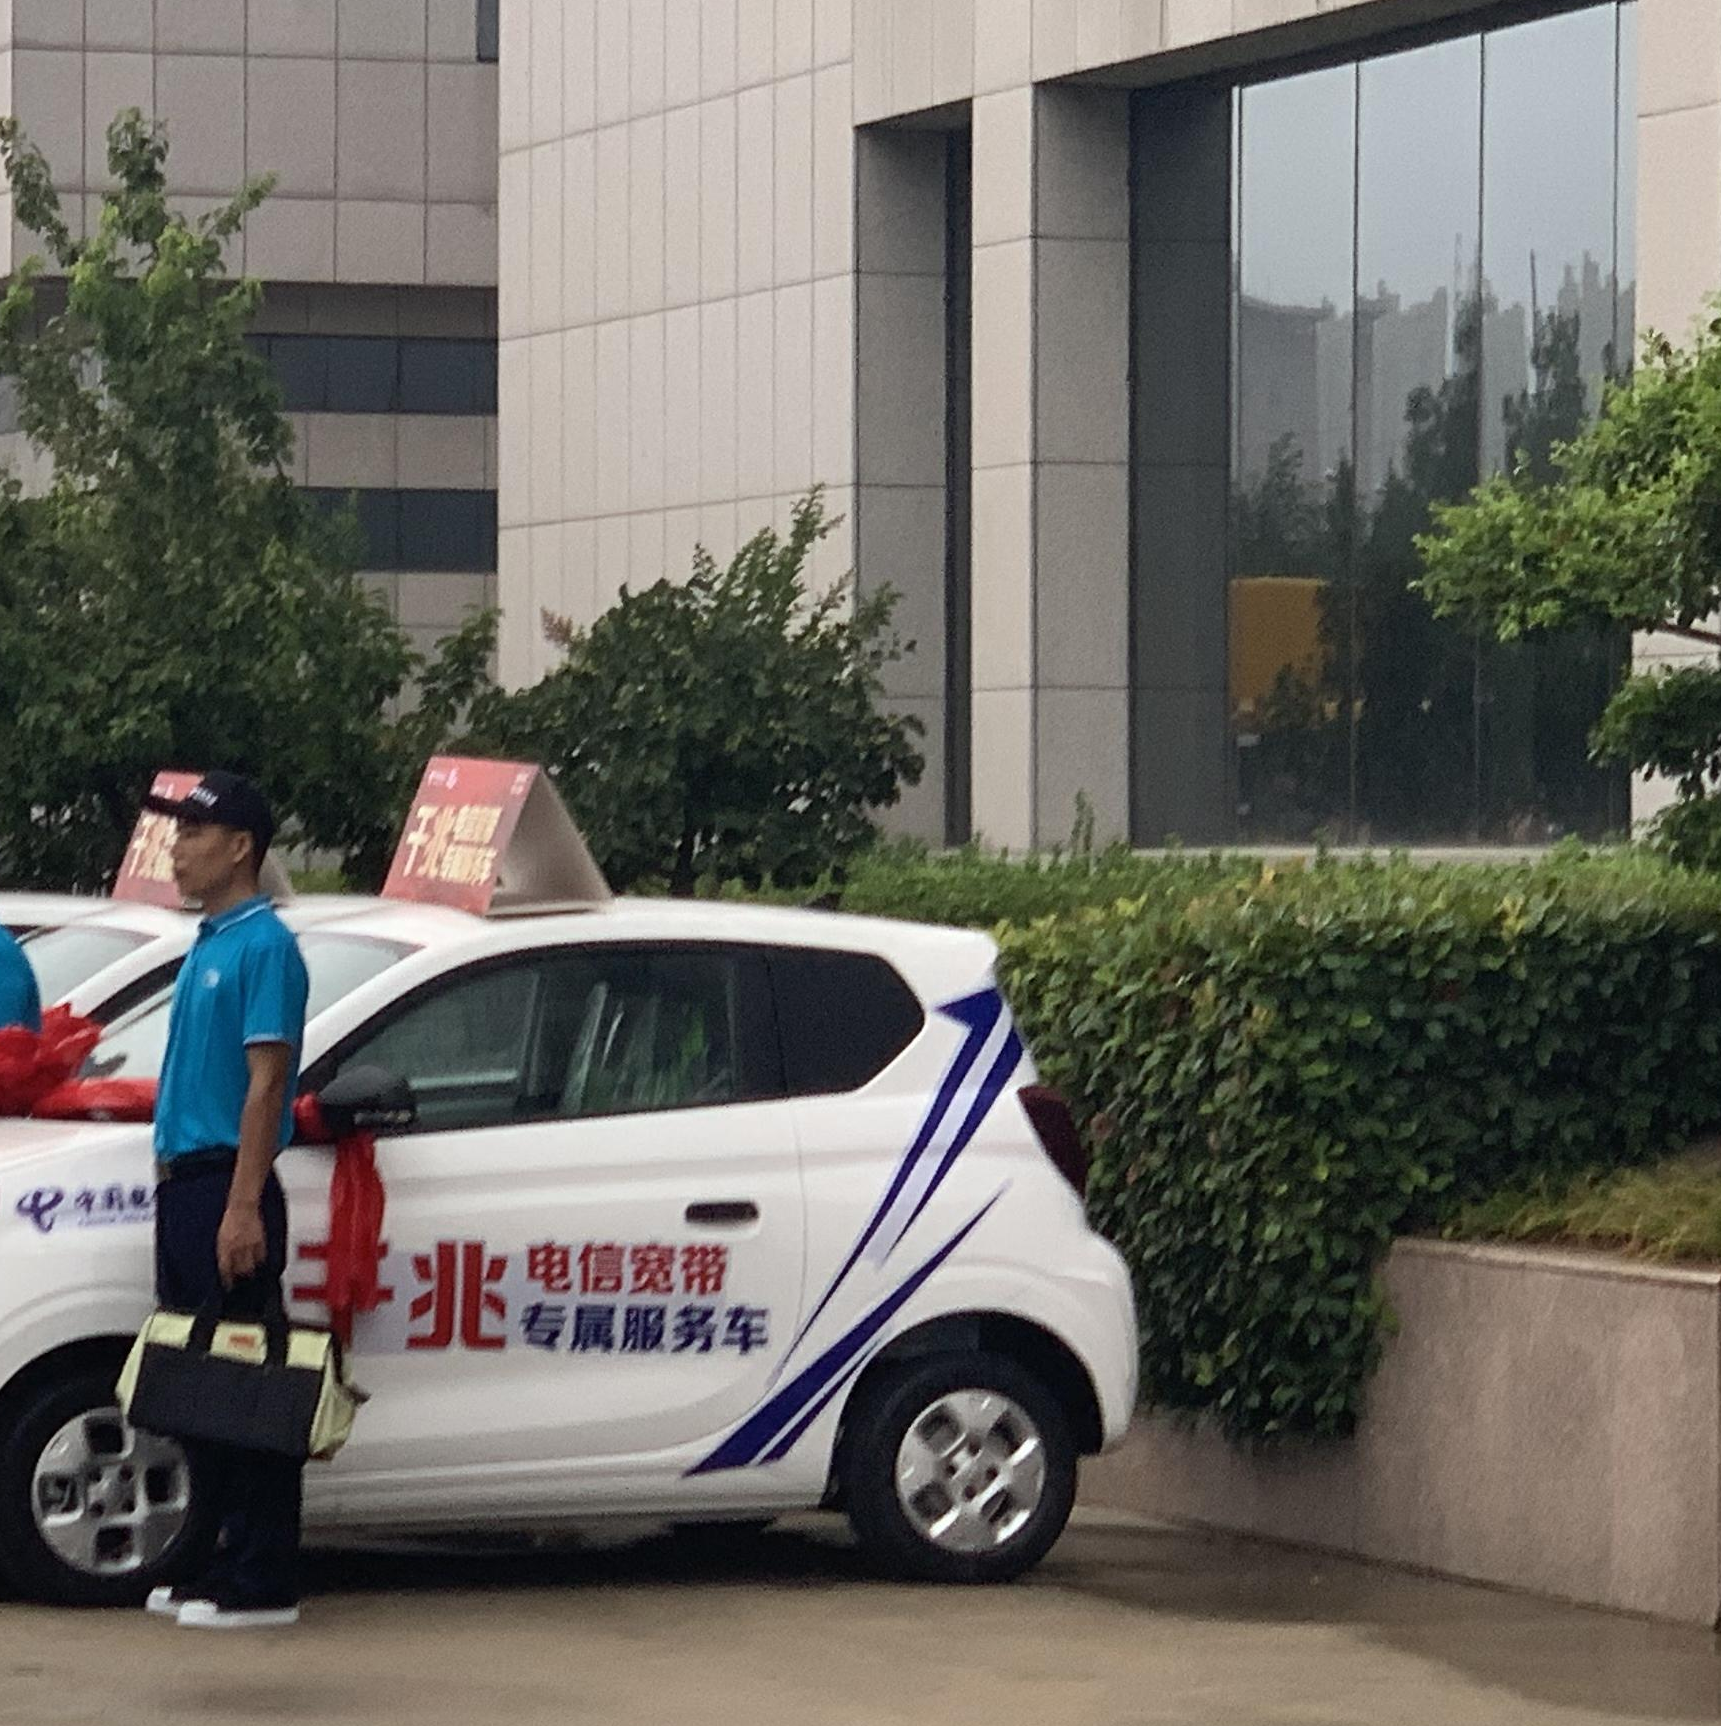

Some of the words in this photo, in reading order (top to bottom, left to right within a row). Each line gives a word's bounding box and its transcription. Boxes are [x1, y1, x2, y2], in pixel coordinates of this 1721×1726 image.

[527, 1241, 728, 1294] 电信宽带
[521, 1302, 769, 1355] 专属服务车
